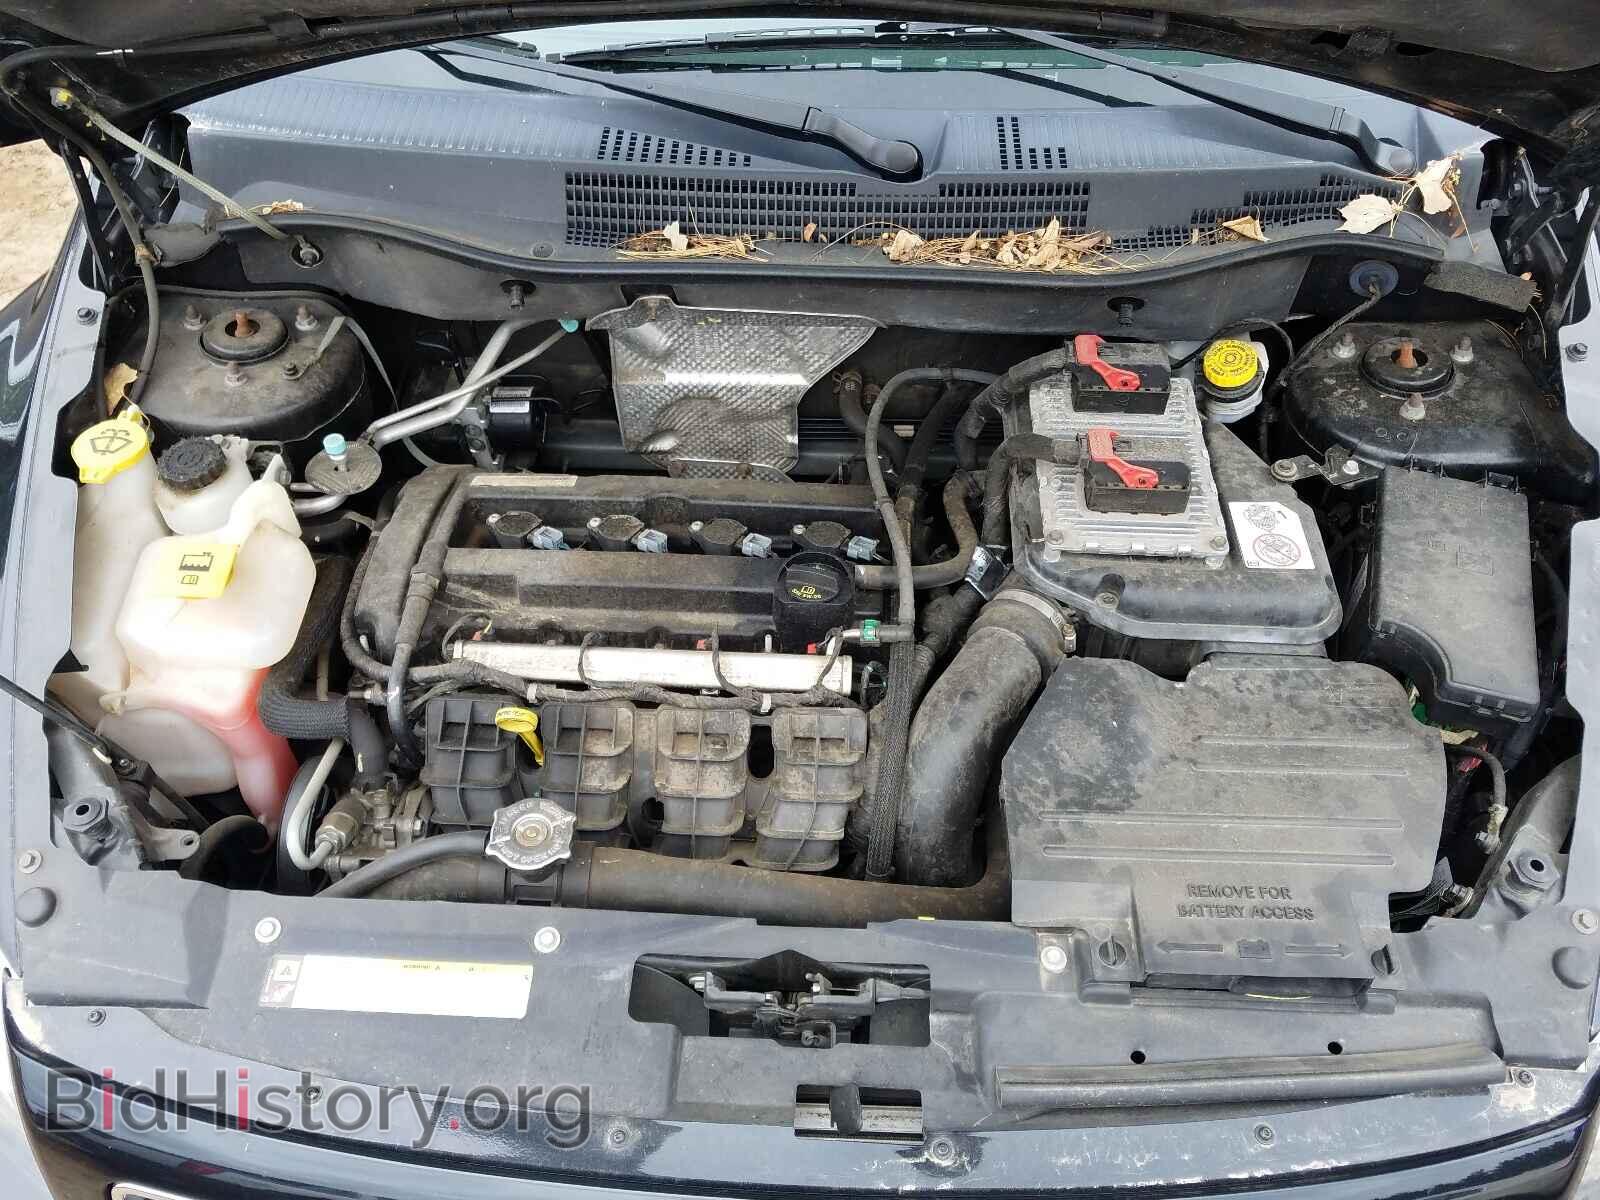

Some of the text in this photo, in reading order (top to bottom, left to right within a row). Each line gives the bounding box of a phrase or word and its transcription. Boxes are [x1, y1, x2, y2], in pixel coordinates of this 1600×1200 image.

[1186, 884, 1293, 900] REMOVE FOR
[1177, 904, 1314, 920] BATTERY ACCESS
